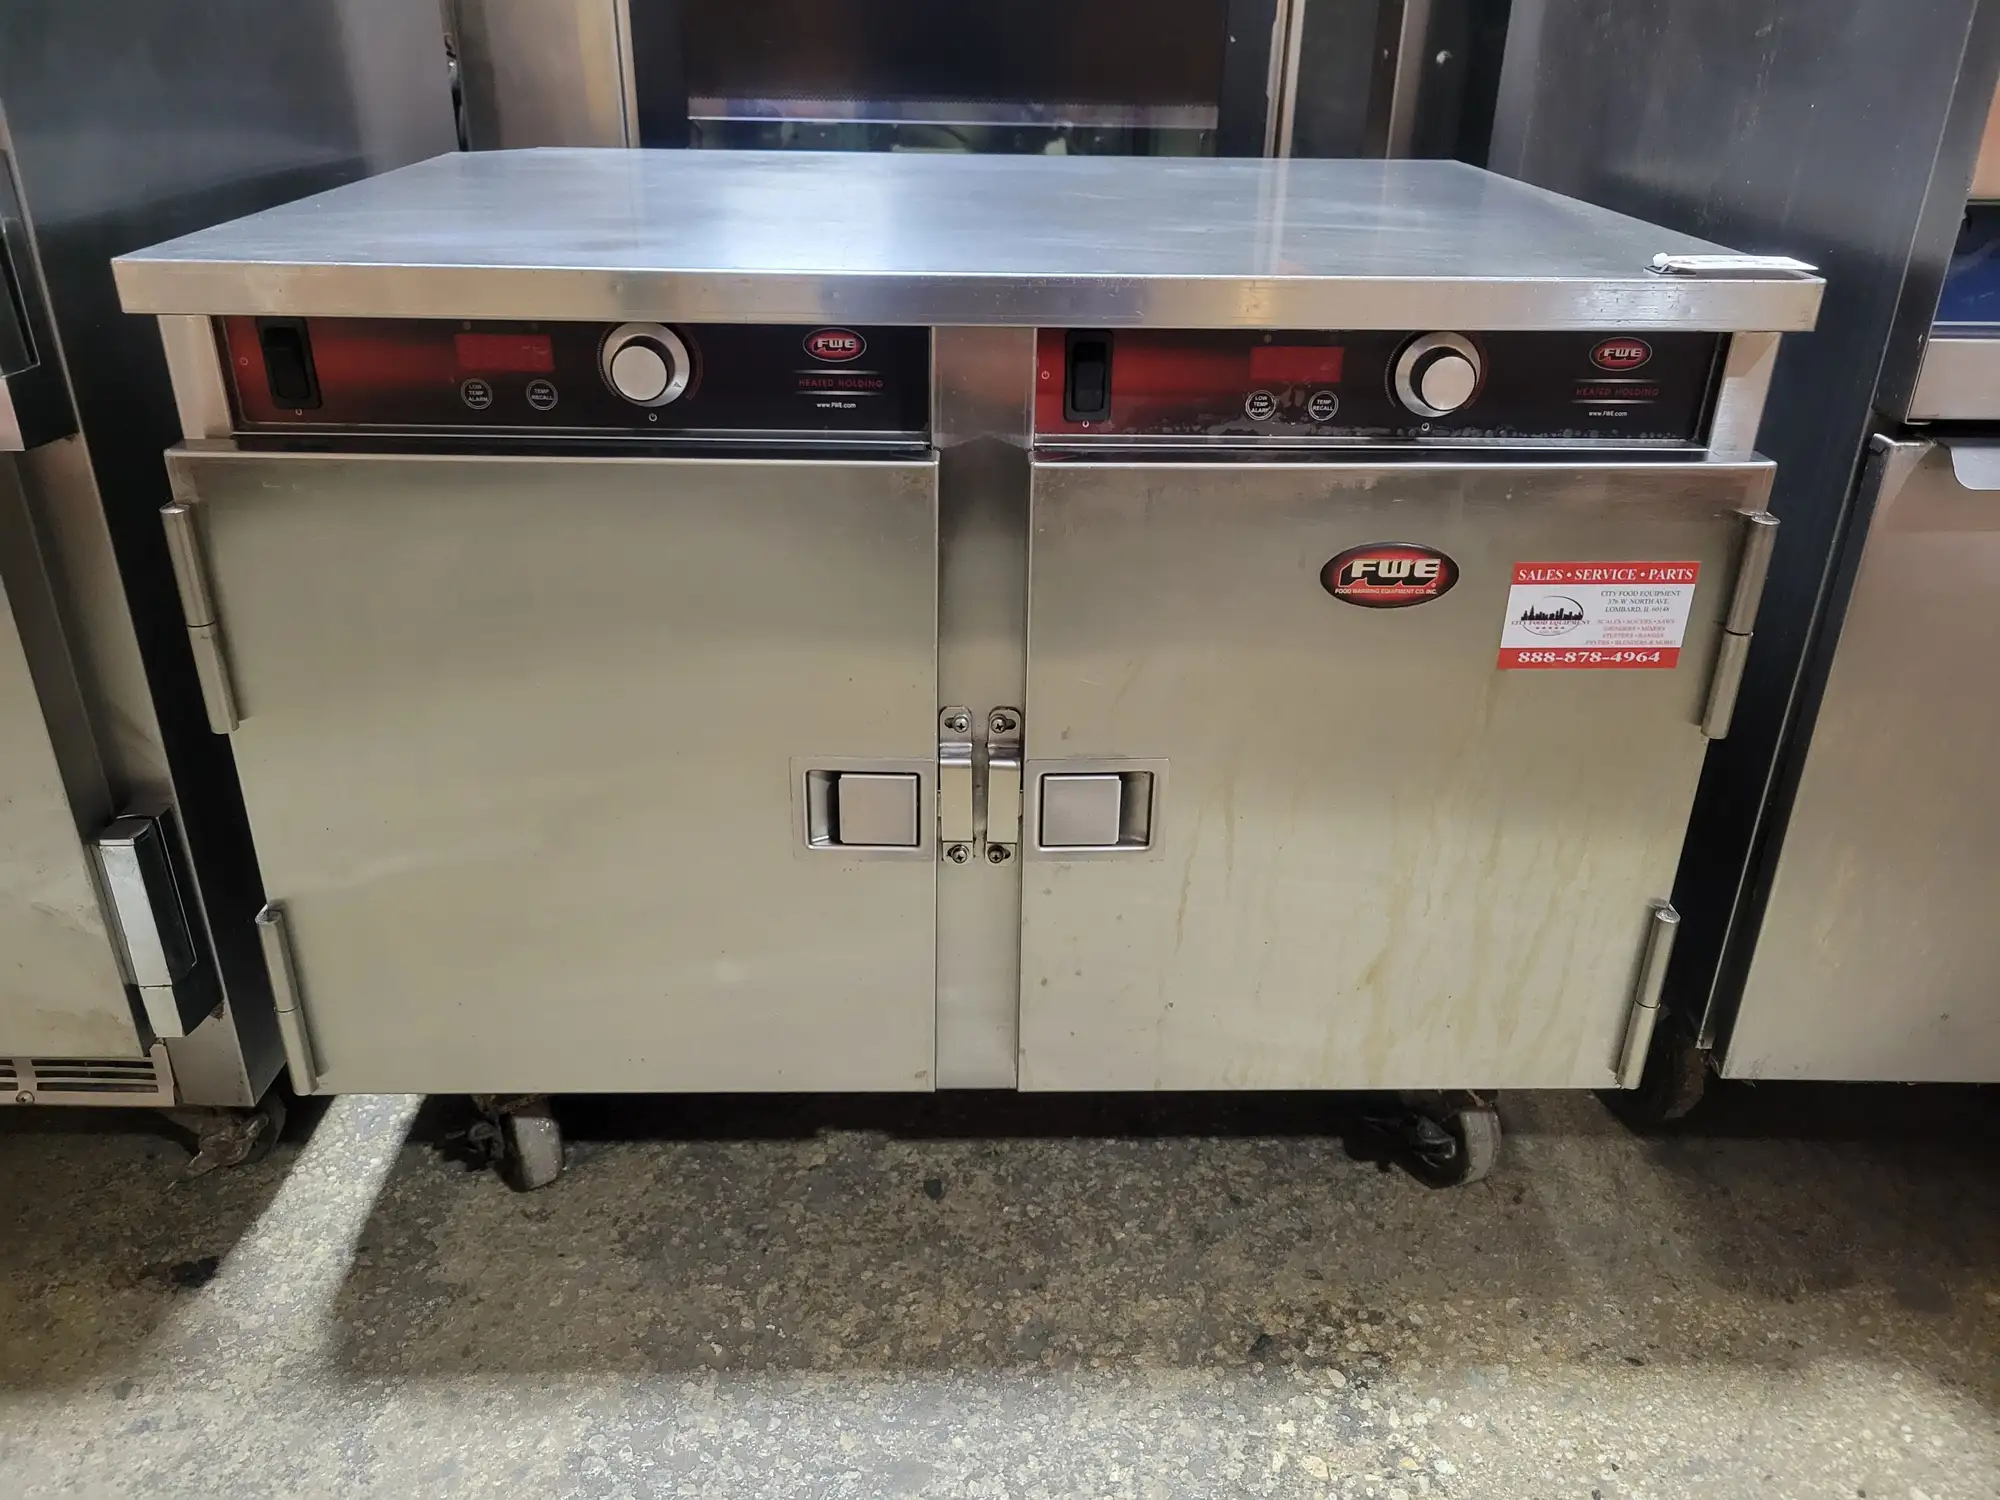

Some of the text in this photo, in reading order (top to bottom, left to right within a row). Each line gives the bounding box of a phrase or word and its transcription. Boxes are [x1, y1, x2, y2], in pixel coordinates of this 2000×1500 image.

[812, 338, 857, 352] FWE
[1598, 347, 1643, 361] FWE
[799, 379, 883, 388] HEATED HOLDING
[1576, 388, 1660, 397] HEATED HOLDING
[1338, 558, 1442, 588] FWE
[1518, 568, 1694, 581] SALES SERVICE PARTS
[1517, 651, 1660, 664] 888-878-4964
